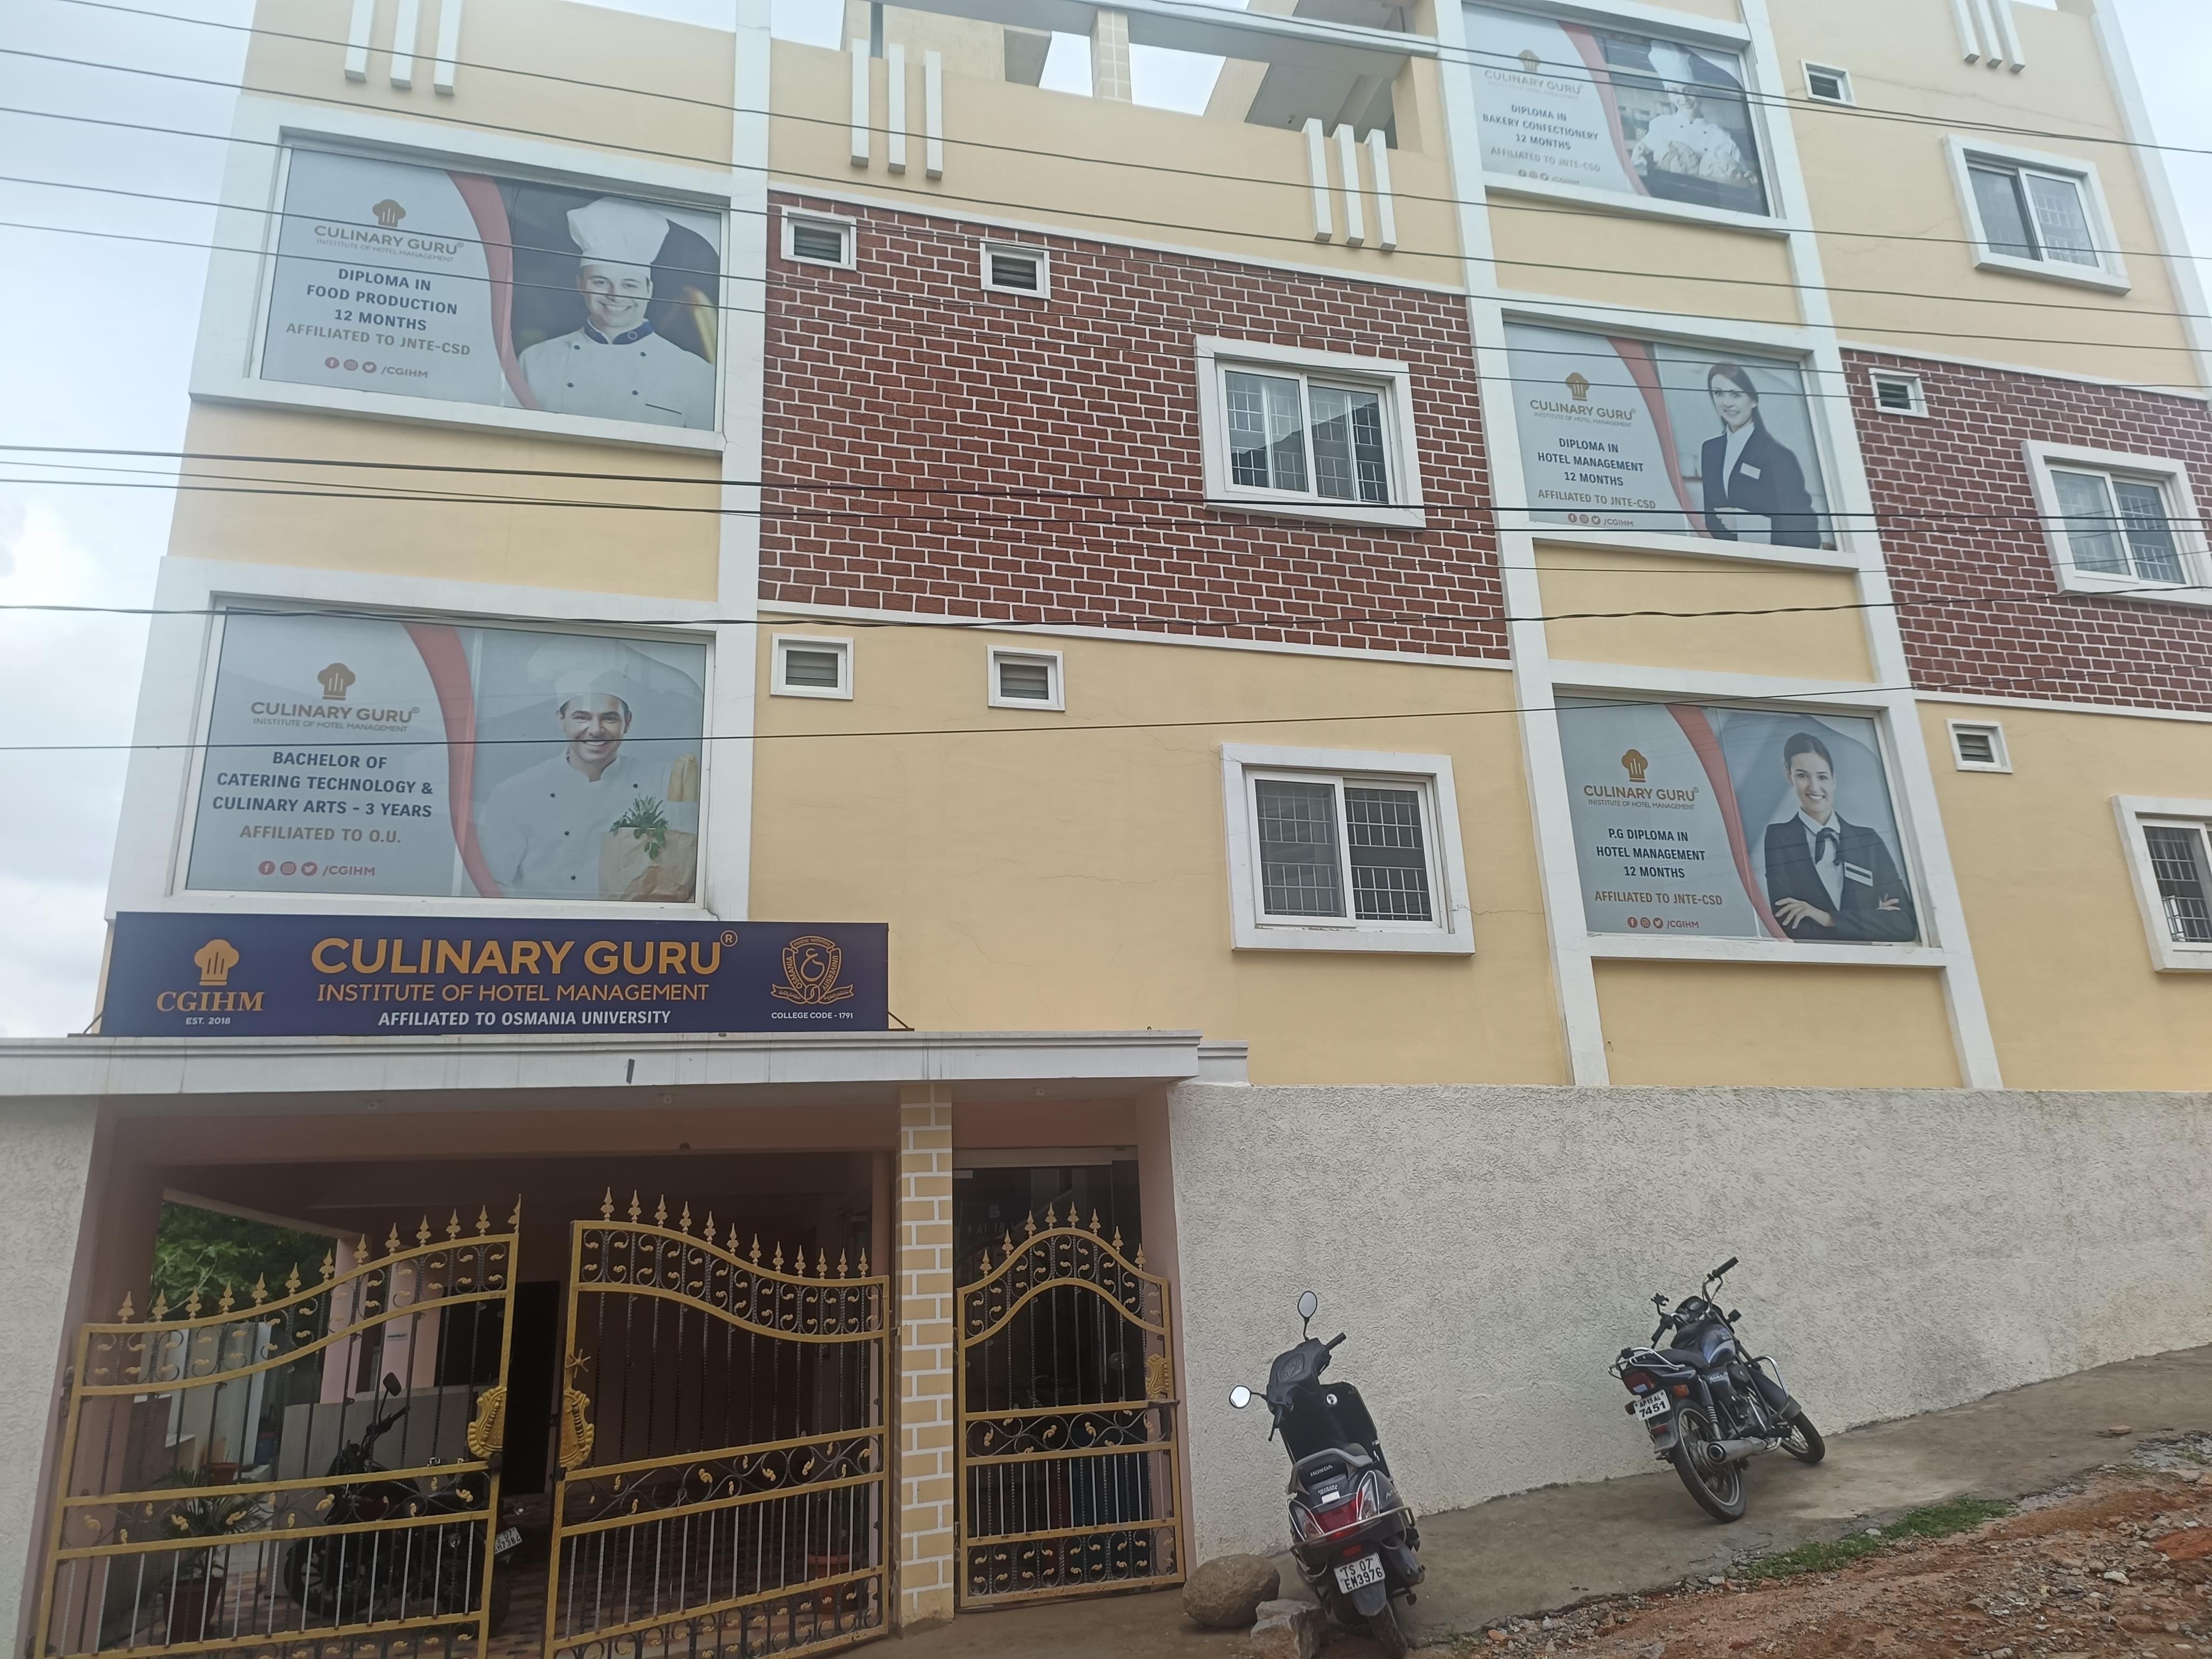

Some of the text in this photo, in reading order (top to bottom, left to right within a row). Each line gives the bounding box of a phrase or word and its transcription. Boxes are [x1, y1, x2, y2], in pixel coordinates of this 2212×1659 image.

[1485, 70, 1543, 88] CULINARY
[1512, 104, 1567, 121] DIPLOMA IN
[1483, 114, 1599, 140] BAKERY CONFECTIONERY
[1516, 134, 1571, 150] 12 MONTHS
[1491, 146, 1601, 172] AFFILIATED TO JNTE-CSD
[314, 225, 403, 247] CULINARY
[373, 246, 397, 255] HOTEL
[400, 250, 454, 262] MANAGEMENT
[339, 269, 431, 291] DIPLOMA IN
[307, 285, 458, 315] FOOD PRODUCTION
[335, 309, 427, 331] 12 MONTHS
[286, 323, 471, 356] AFFILIATED TO JNTE-CSD
[1530, 400, 1593, 416] CULINARY
[1593, 419, 1632, 428] MANAGEMENT
[1559, 438, 1618, 453] DIPLOMA IN
[1538, 452, 1644, 472] HOTEL MANAGEMENT
[1564, 471, 1624, 486] 12 MONTHS
[1538, 489, 1656, 509] AFFILIATED TO JNTE-CSD
[251, 702, 353, 719] CULINARY
[347, 723, 409, 732] MANAGEMENT
[273, 752, 387, 769] BACHELOR OF
[217, 773, 434, 794] CATERING TECHNOLOGY &
[1584, 785, 1653, 799] CULINARY
[212, 797, 298, 812] CULINARY
[303, 800, 347, 814] ARTS
[365, 802, 374, 815] 3
[381, 804, 433, 818] YEARS
[240, 825, 401, 843] AFFILIATED TO O.U.
[1608, 828, 1689, 841] P.G DIPLOMA IN
[1596, 846, 1705, 861] HOTEL MANAGEMENT
[322, 865, 376, 876] /CGIHM
[1624, 866, 1685, 878] 12 MONTHS
[1595, 891, 1723, 905] AFFILIATED TO JNTE-CSD
[1667, 920, 1700, 929] /CGIHM
[311, 938, 575, 975] CULINARY
[786, 956, 803, 989] OSMANIA
[821, 955, 838, 990] UNIVERSITY
[157, 991, 265, 1011] CGIHM
[317, 984, 709, 1002] INSTITUTE OF HOTEL MANAGEMENT
[186, 1017, 231, 1025] EST. 2018
[378, 1010, 671, 1026] AFFILIATED TO OSMANIA UNIVERSITY
[1639, 1401, 1665, 1418] 7451
[1640, 1400, 1647, 1408] AP
[1310, 1465, 1333, 1477] HONDA
[503, 1530, 512, 1540] 07
[1342, 1558, 1371, 1578] TS 07
[1344, 1567, 1383, 1590] EM3976
